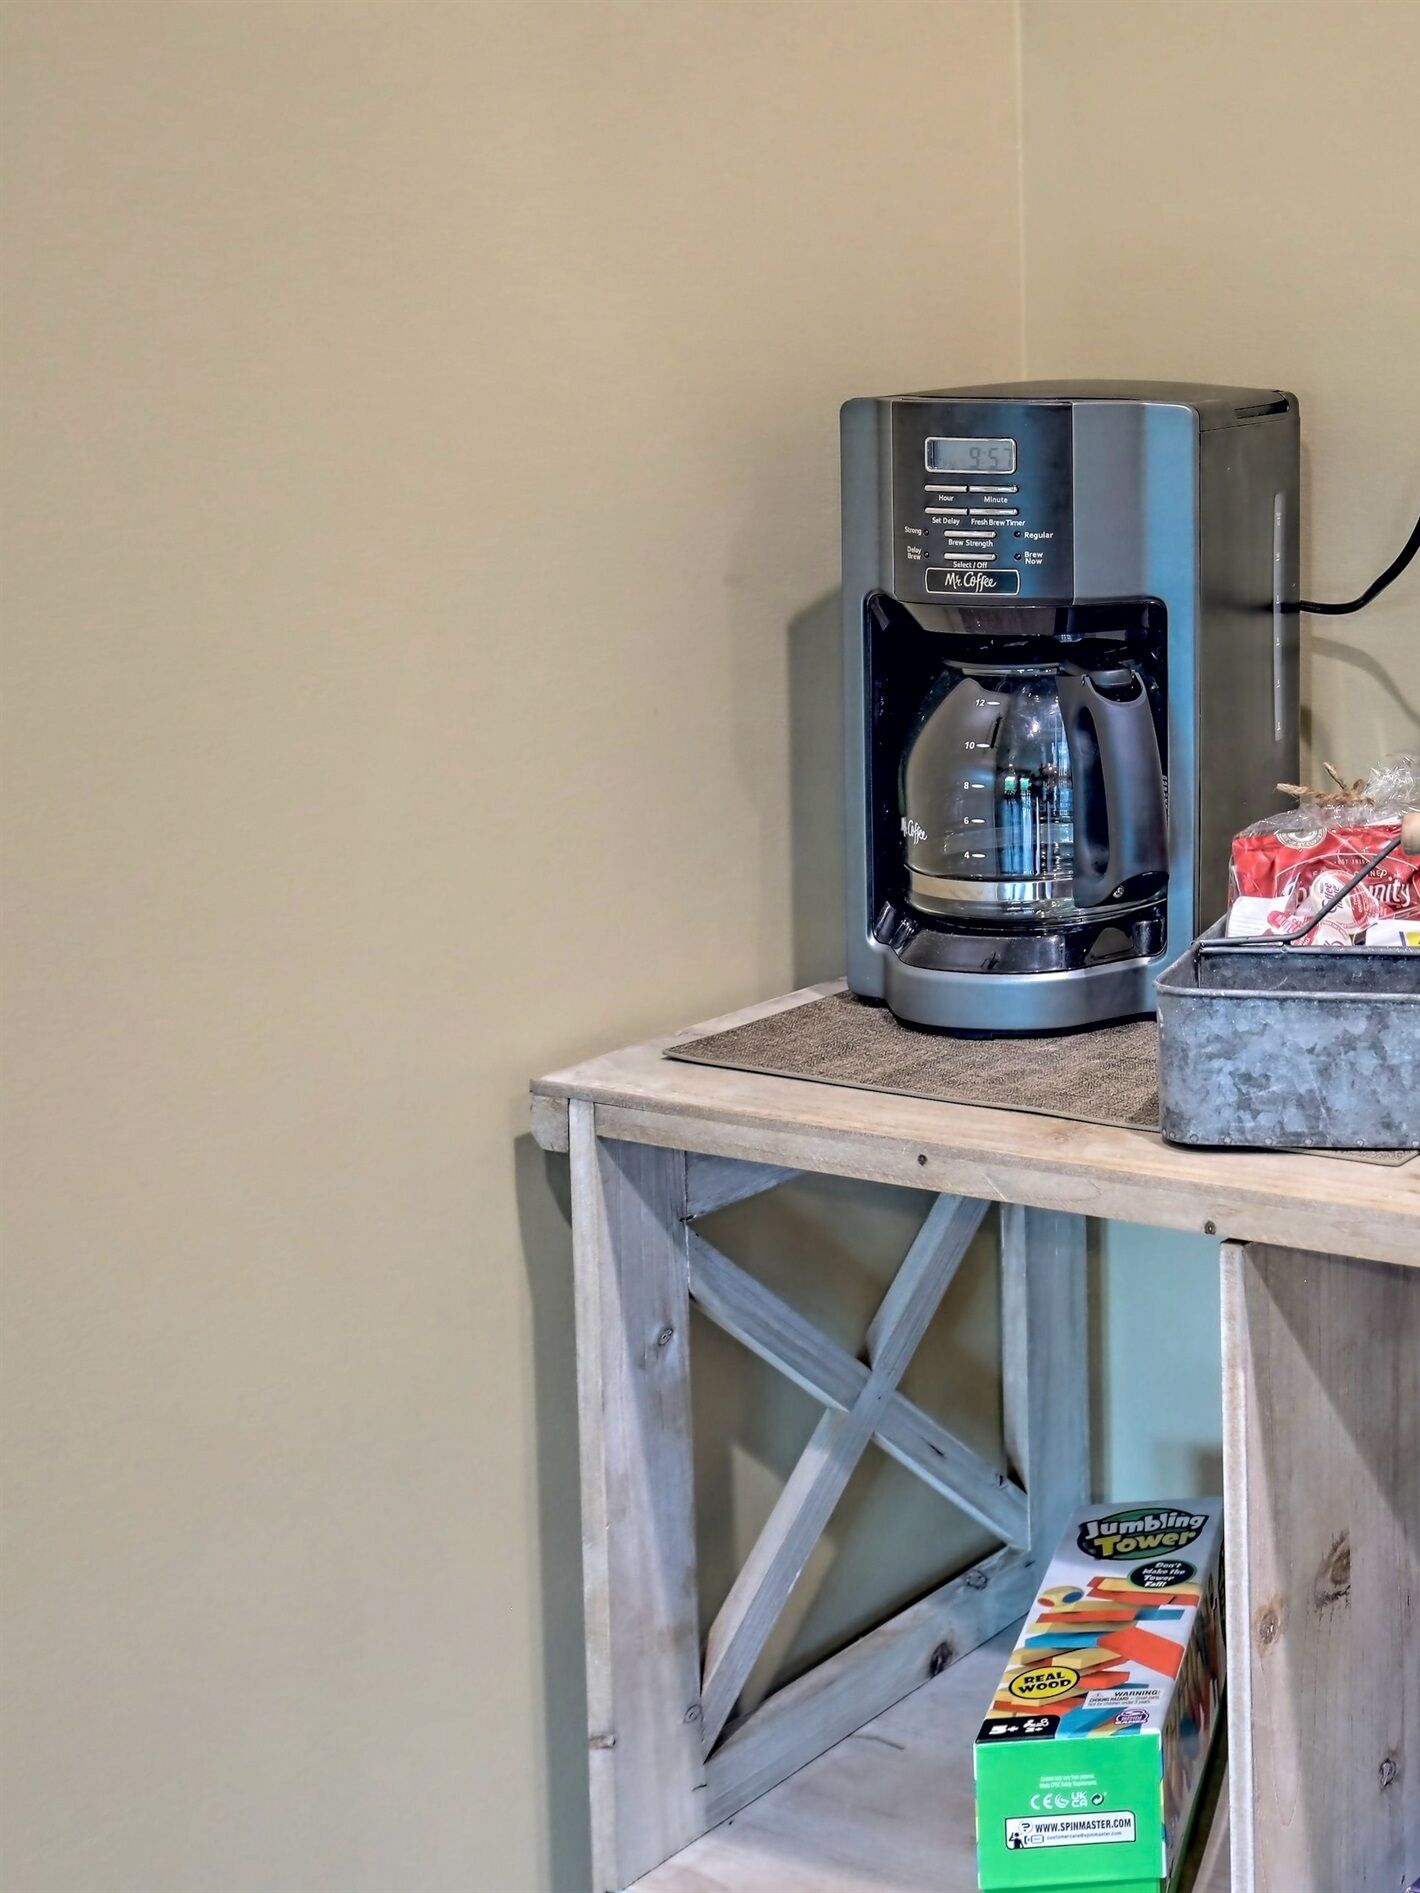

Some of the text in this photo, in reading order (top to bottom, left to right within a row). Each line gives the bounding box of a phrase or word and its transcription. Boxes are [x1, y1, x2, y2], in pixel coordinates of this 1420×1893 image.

[943, 518, 960, 526] Delay
[971, 518, 988, 526] Fresh
[904, 527, 922, 535] Strong
[1024, 532, 1053, 540] Regular
[966, 540, 993, 549] Strength
[907, 546, 922, 554] Delay
[944, 571, 997, 592] Mr. Coffee
[975, 699, 985, 707] 12
[964, 742, 975, 750] 10
[964, 817, 969, 825] 6
[908, 820, 927, 844] Coffee
[1085, 1512, 1205, 1540] Jumbling
[1094, 1531, 1196, 1557] Tower
[1024, 1672, 1065, 1684] REAL
[1018, 1679, 1072, 1694] WOOD
[989, 1725, 1019, 1735] 5+
[1071, 1791, 1087, 1799] UK
[1071, 1800, 1088, 1808] CA
[1035, 1818, 1131, 1833] WWW.SPINMASTER.COM
